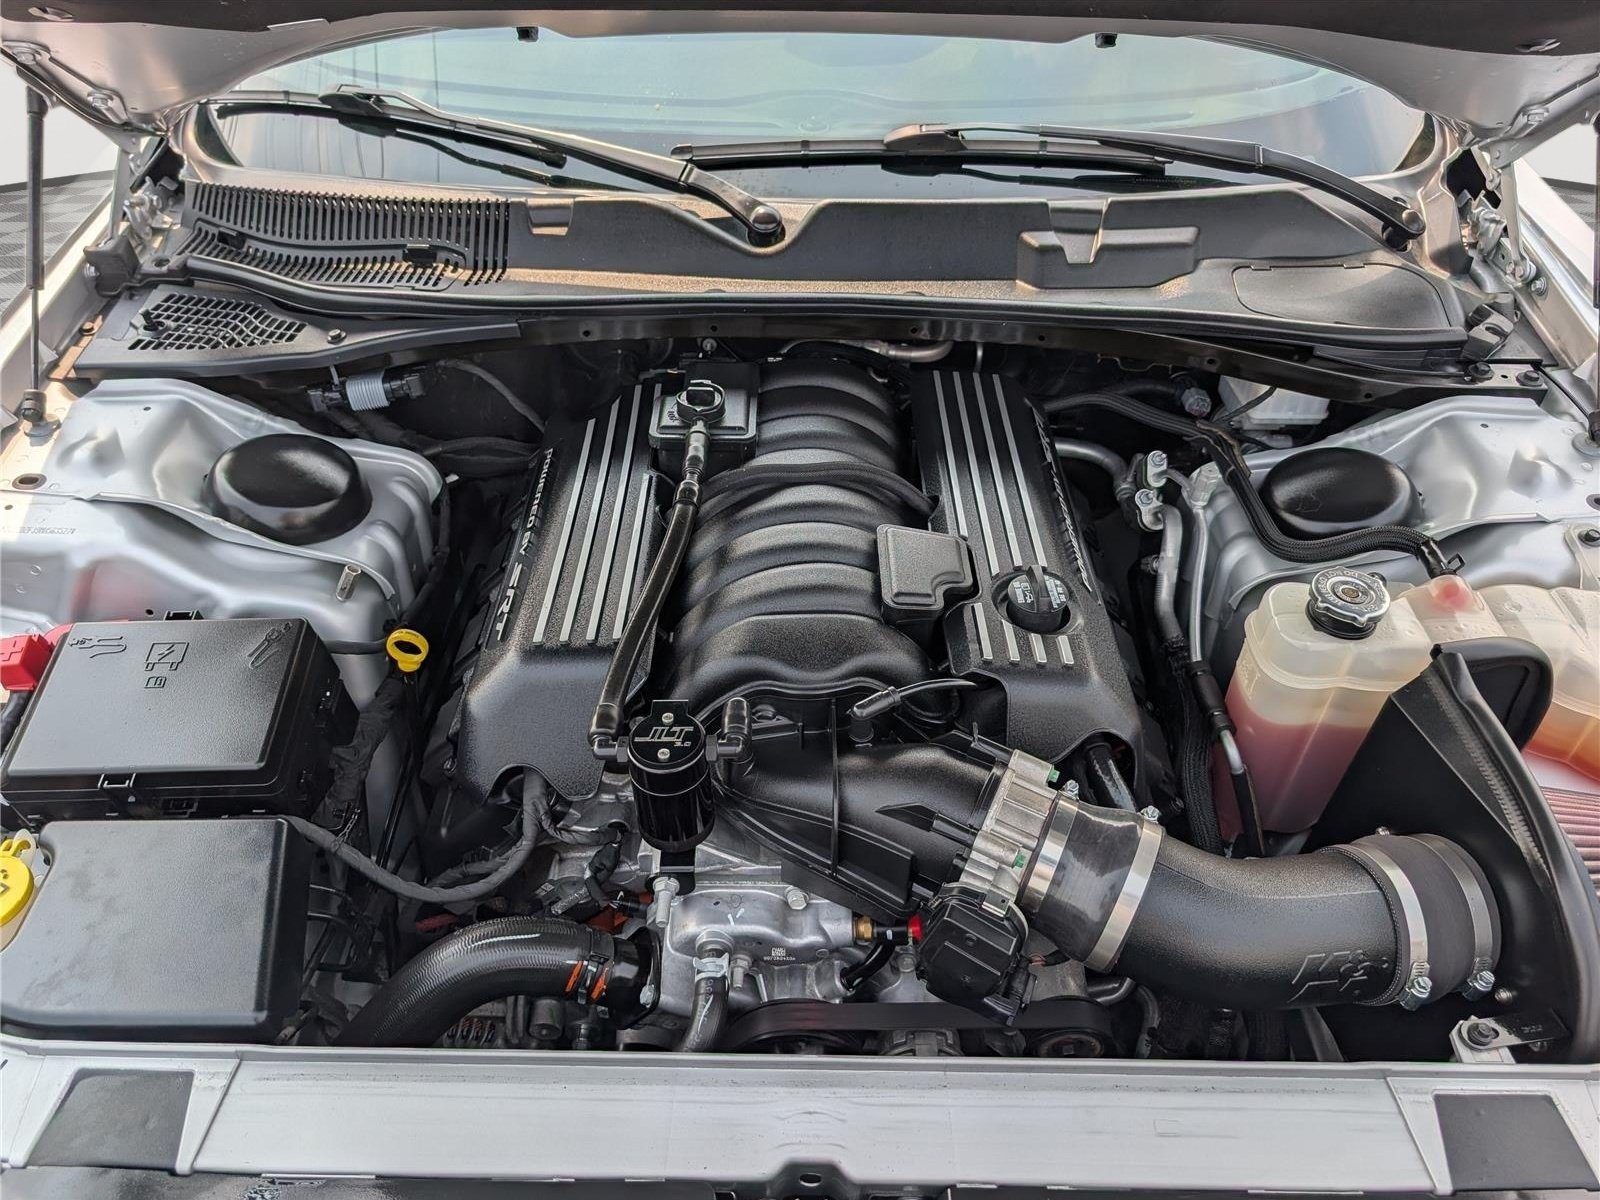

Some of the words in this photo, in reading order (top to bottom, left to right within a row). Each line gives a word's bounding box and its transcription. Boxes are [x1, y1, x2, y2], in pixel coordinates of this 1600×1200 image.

[527, 447, 553, 528] POWERED
[519, 531, 532, 557] BY
[495, 562, 523, 641] SRT
[634, 726, 694, 742] JLT
